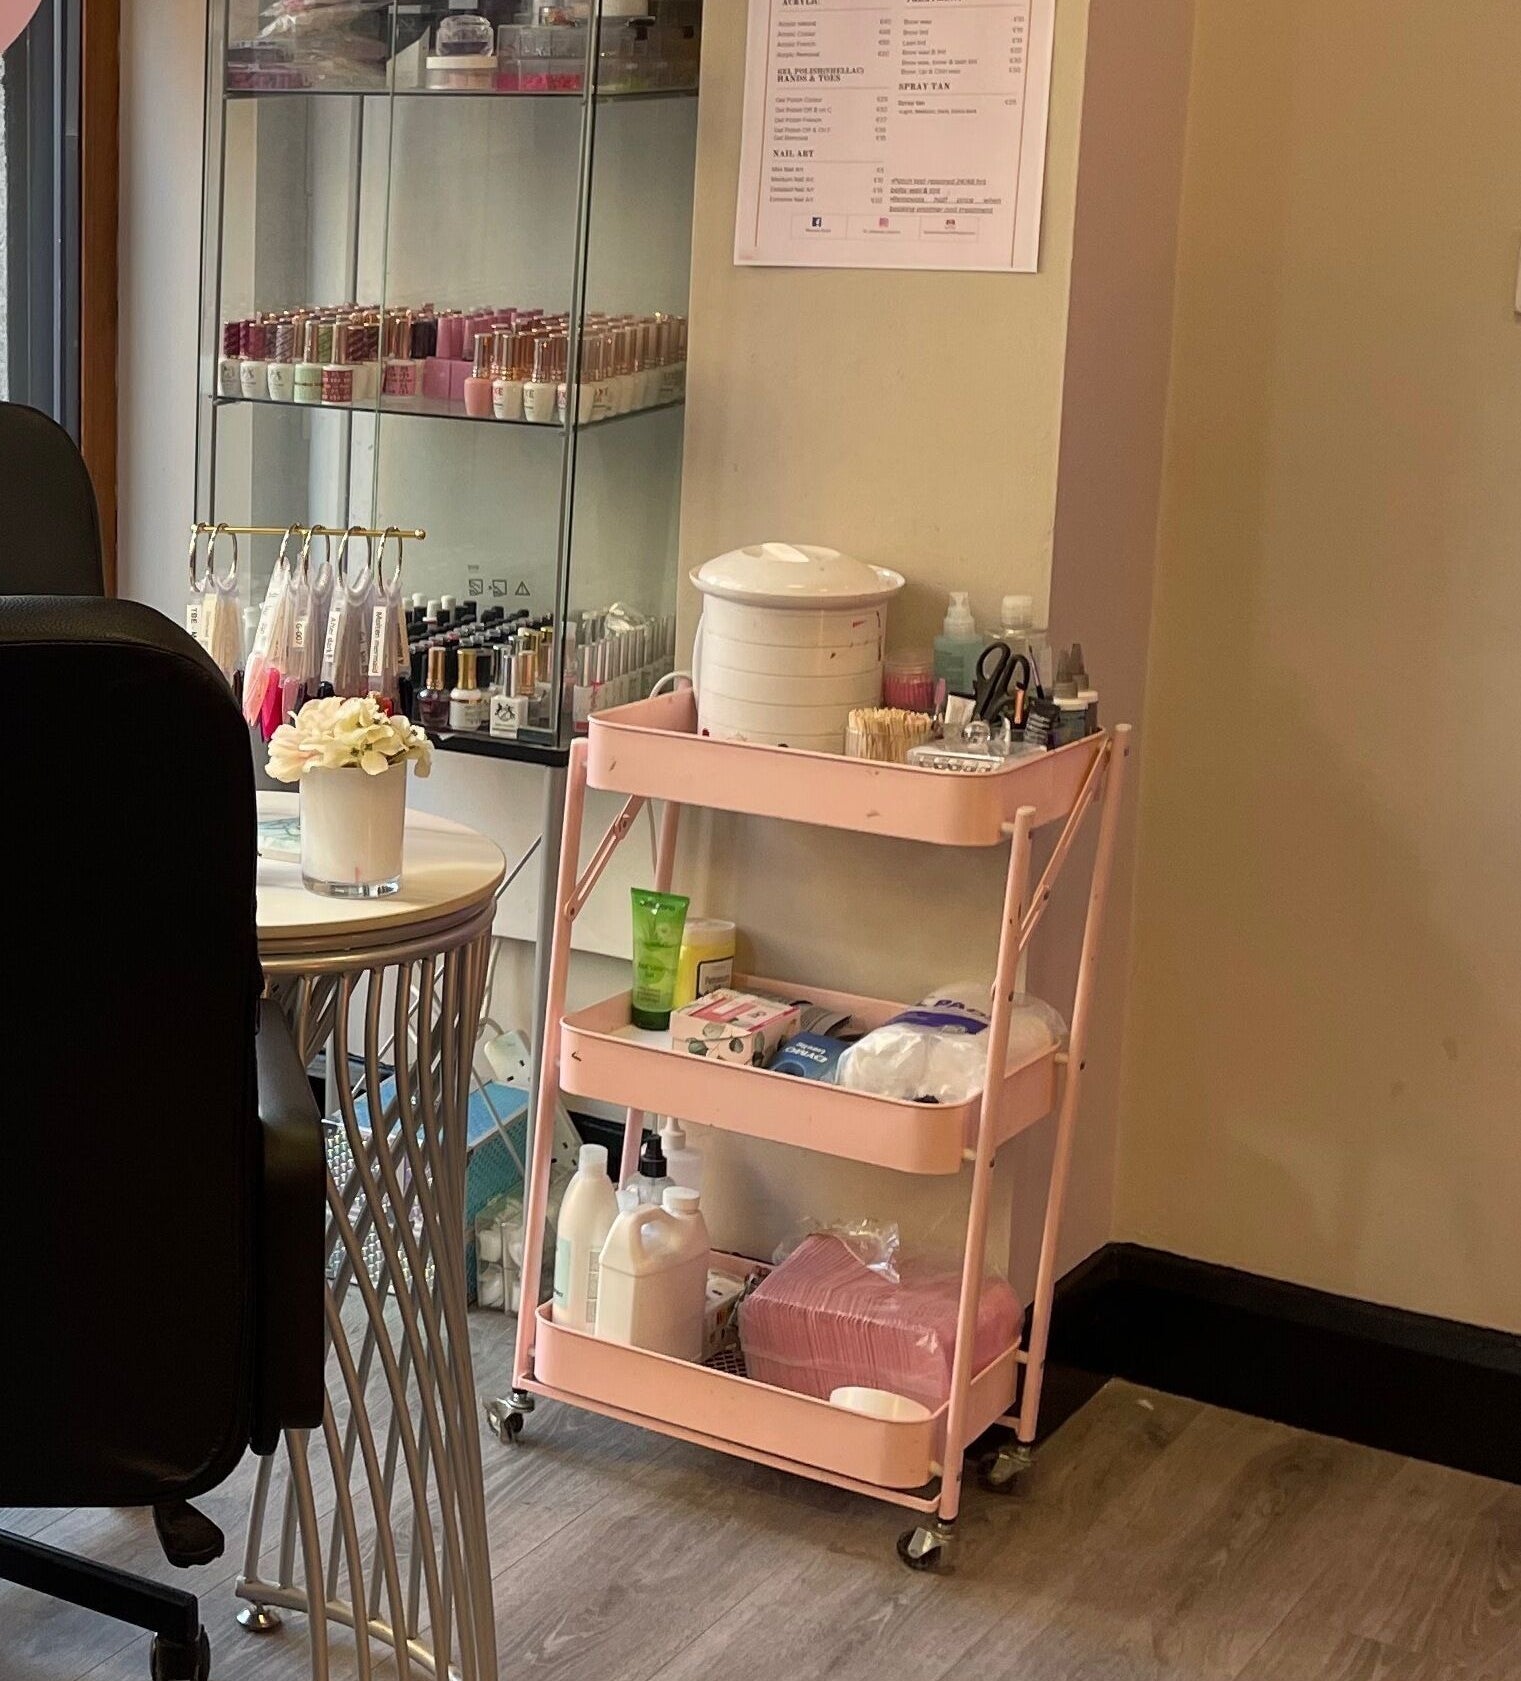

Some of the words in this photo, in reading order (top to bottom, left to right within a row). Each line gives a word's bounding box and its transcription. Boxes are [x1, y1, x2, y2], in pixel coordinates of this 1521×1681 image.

[898, 82, 929, 91] SPRAY
[930, 82, 951, 90] TAN
[773, 149, 795, 158] NAIL
[797, 149, 814, 158] ART
